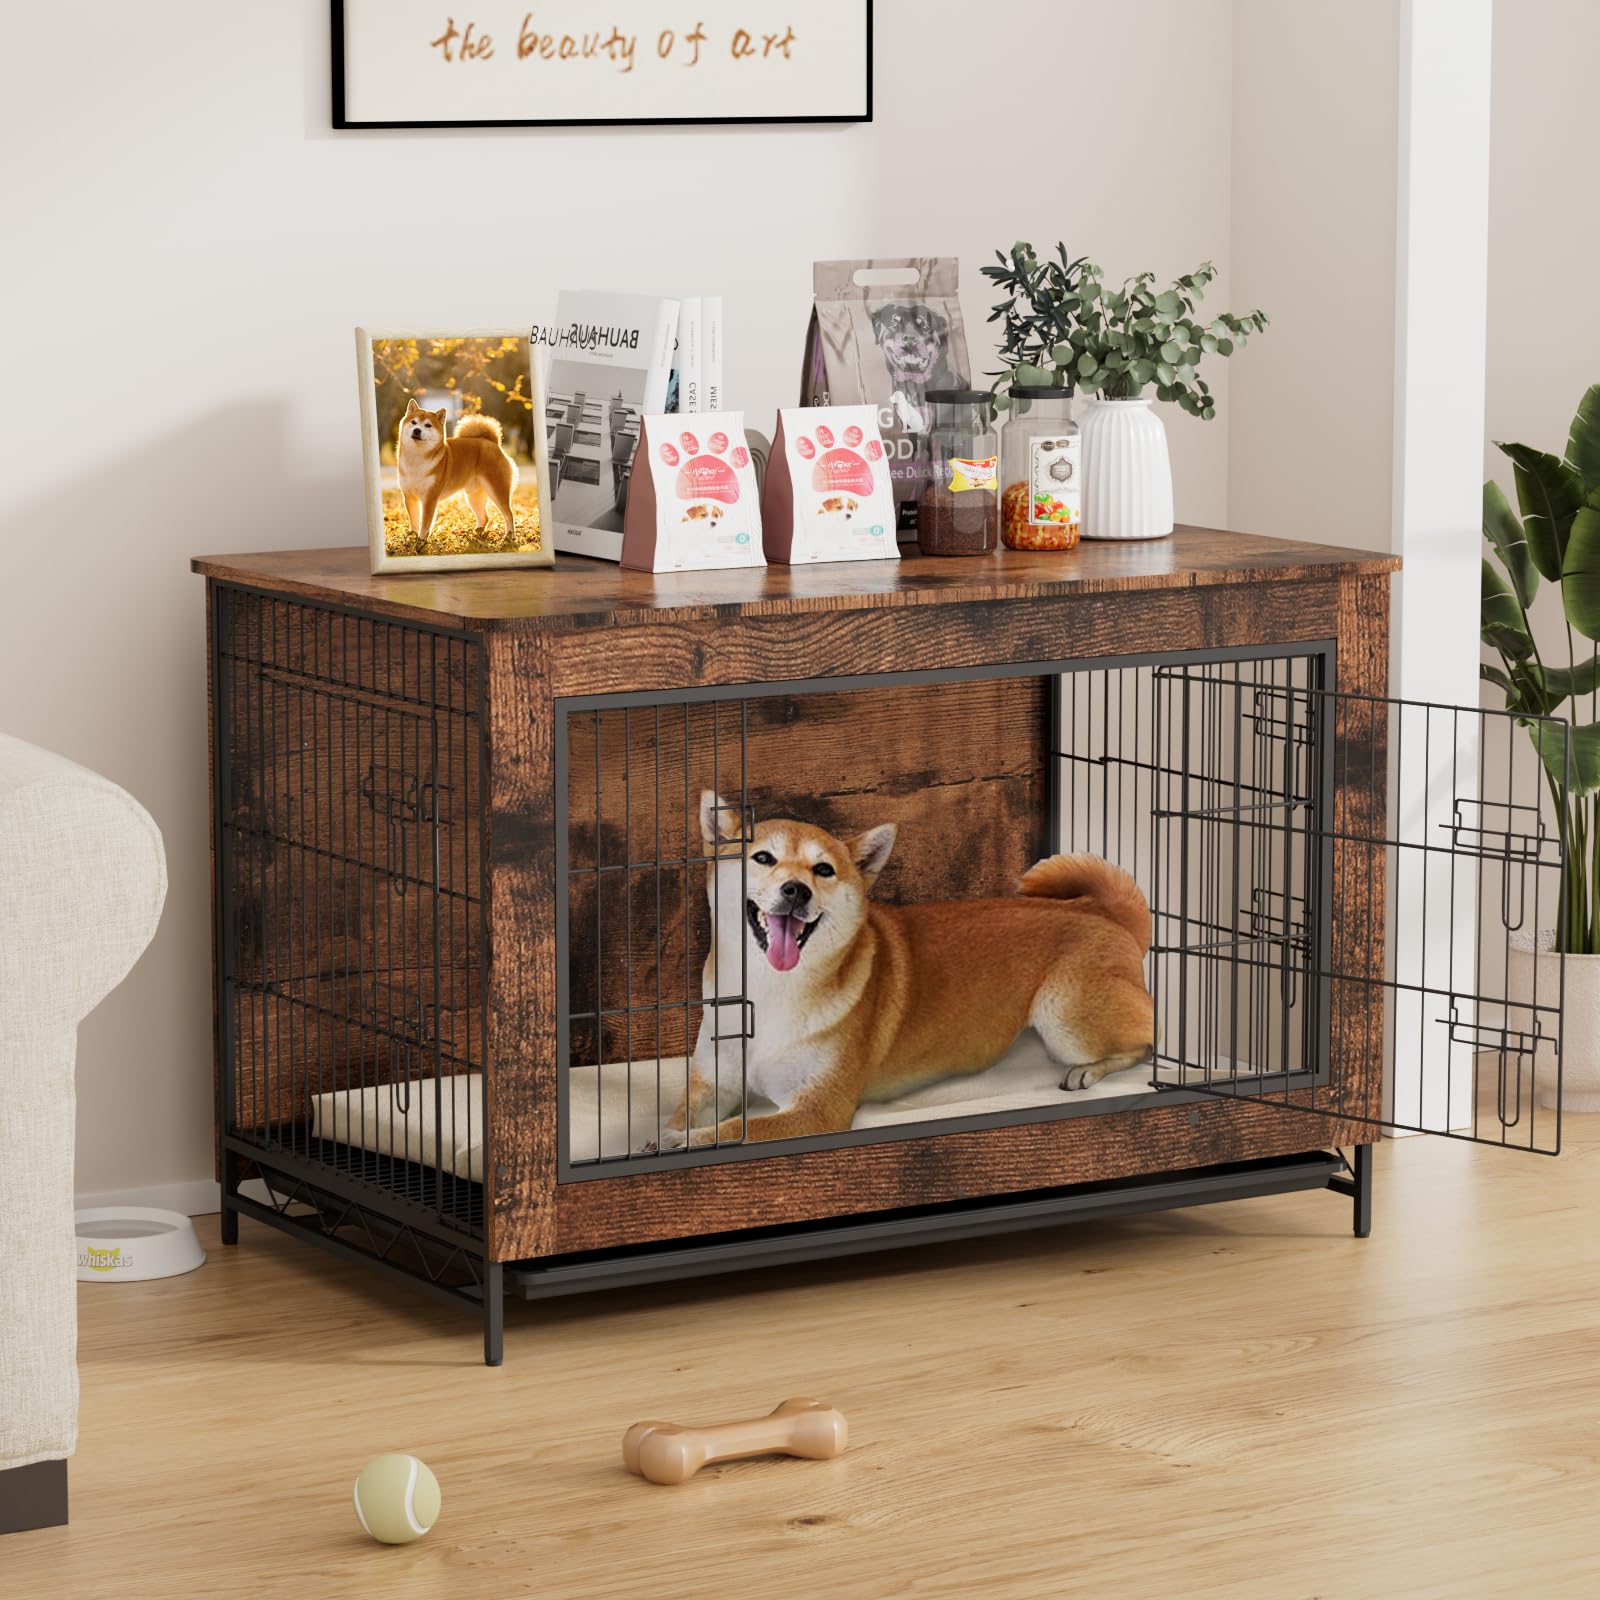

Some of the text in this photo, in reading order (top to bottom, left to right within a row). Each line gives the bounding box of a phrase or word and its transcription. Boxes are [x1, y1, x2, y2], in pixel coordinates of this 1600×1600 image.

[431, 12, 796, 73] the beauty of art
[882, 438, 914, 460] OD
